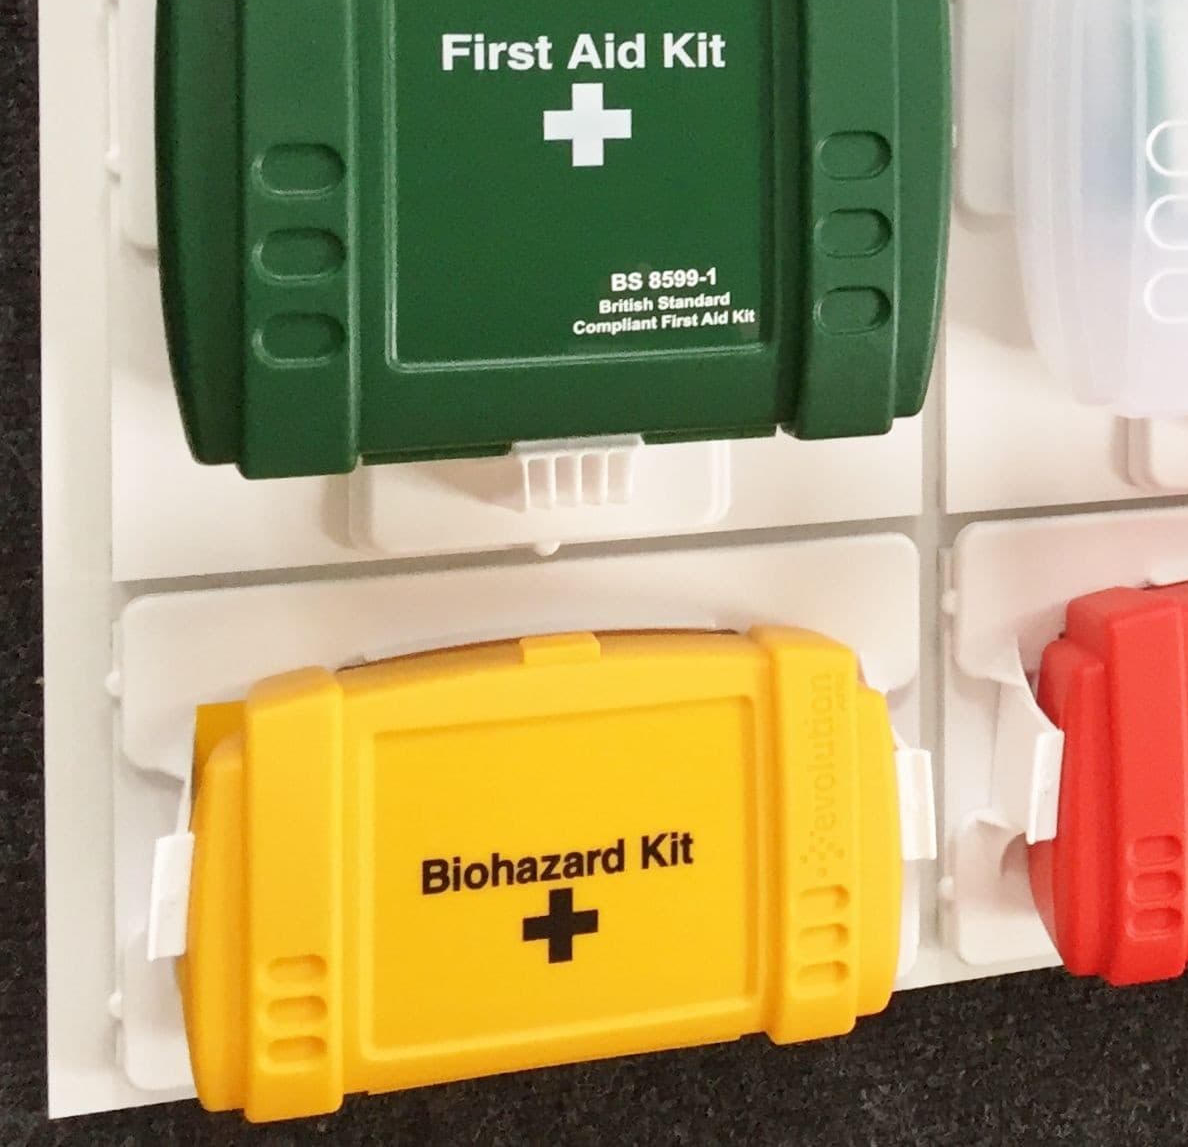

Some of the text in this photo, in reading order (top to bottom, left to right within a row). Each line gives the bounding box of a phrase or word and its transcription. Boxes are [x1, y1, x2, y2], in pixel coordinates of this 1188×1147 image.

[441, 32, 726, 70] First Aid Kit
[610, 267, 717, 292] BS 8599-1
[599, 292, 731, 314] British Standard
[572, 308, 756, 336] Compliant First Aid Kit
[421, 831, 695, 895] Biohazard Kit
